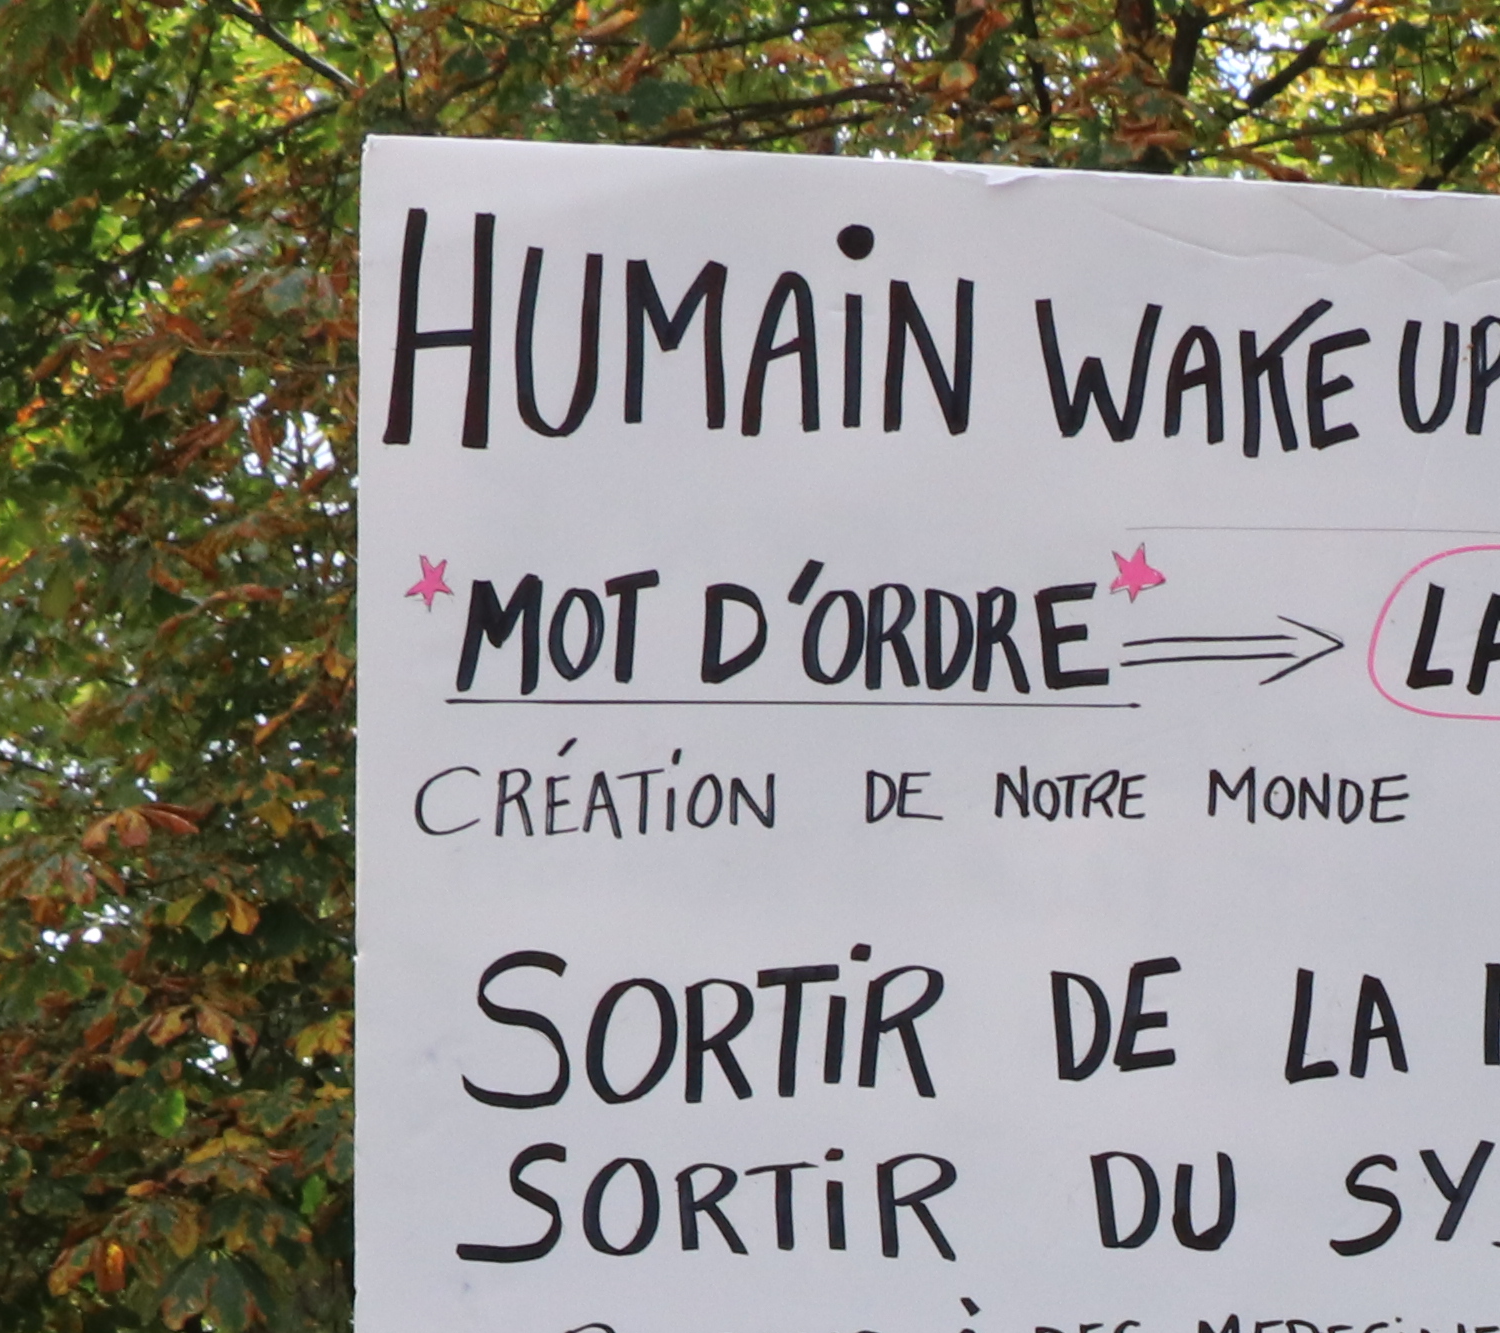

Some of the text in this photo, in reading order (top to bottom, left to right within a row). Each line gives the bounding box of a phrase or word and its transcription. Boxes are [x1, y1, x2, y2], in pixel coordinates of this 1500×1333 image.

[1035, 299, 1371, 458] WAKE
[456, 570, 659, 695] MOT
[701, 560, 1109, 694] D'ORDRE
[866, 770, 943, 823] DE
[995, 766, 1146, 821] NOTRE
[1208, 767, 1409, 824] MONDE
[1051, 957, 1181, 1081] DE
[1285, 968, 1408, 1084] LA
[1090, 1152, 1236, 1251] DU
